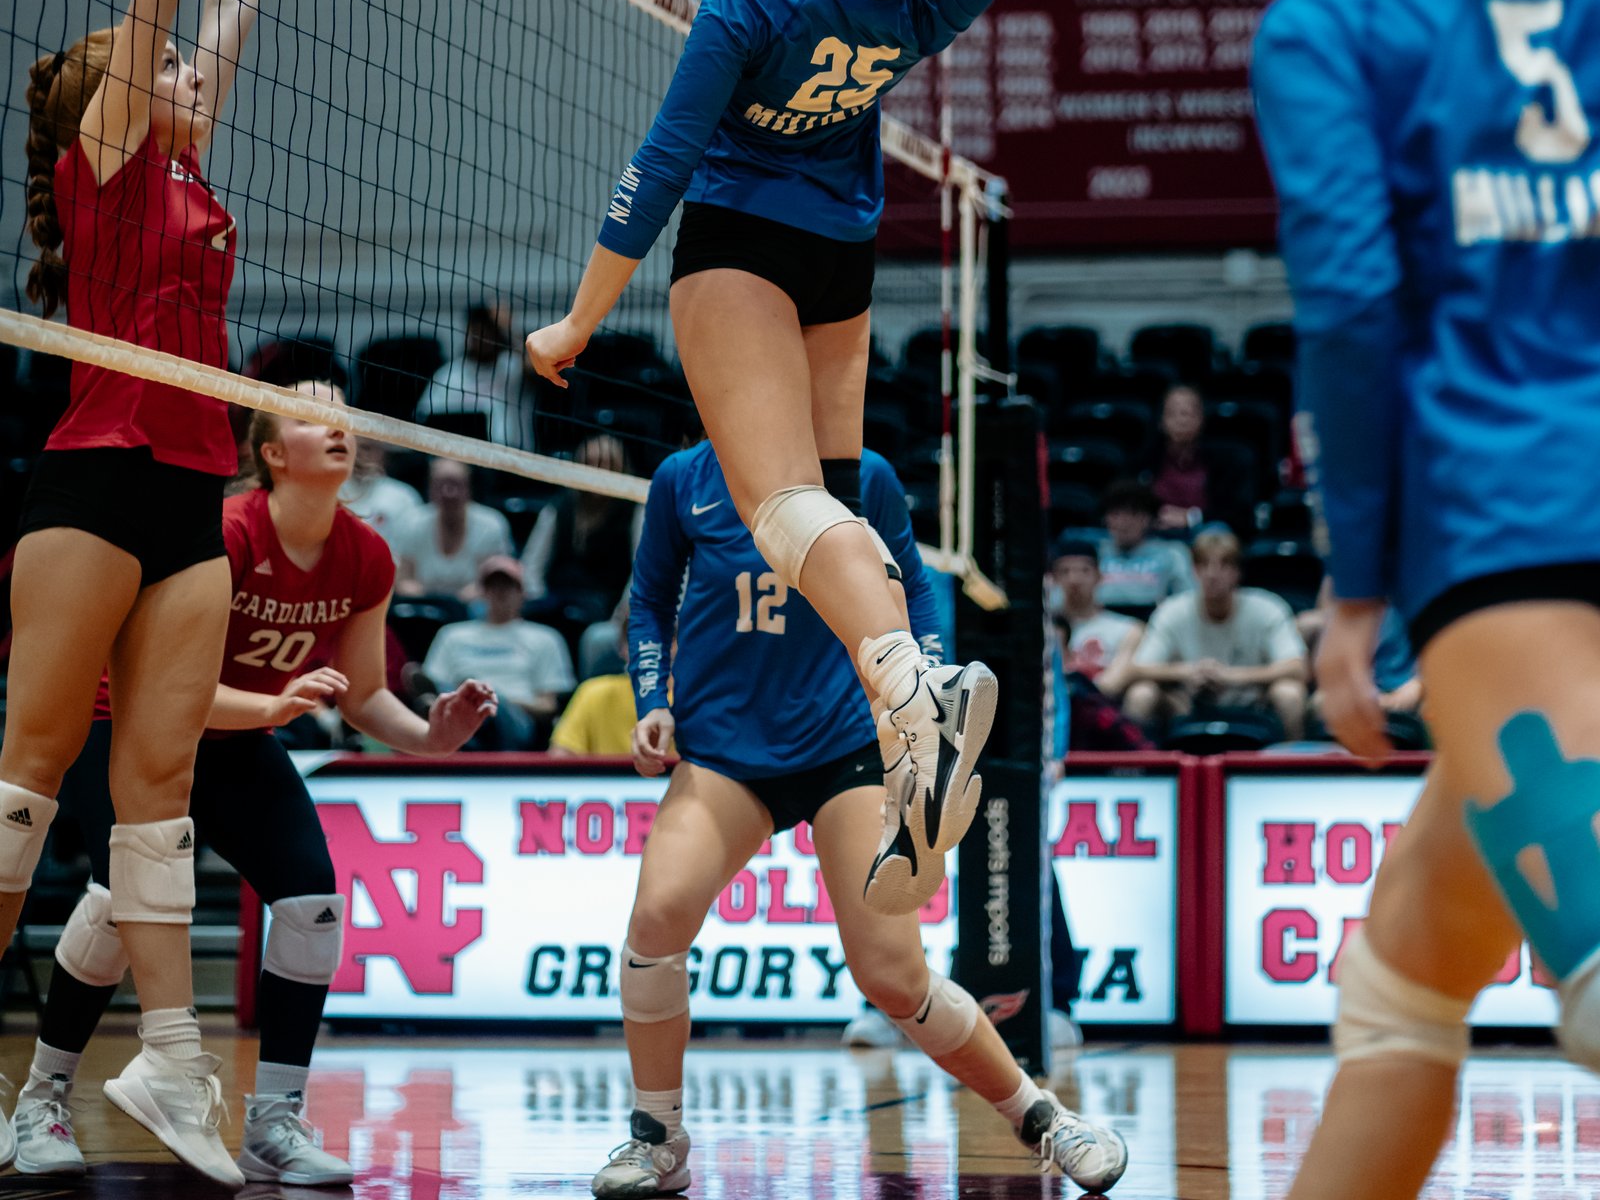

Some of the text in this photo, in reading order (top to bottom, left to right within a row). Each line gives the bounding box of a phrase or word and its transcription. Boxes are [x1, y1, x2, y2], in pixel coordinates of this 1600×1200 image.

[786, 37, 900, 112] 25
[231, 590, 352, 625] CARDINALS
[735, 571, 788, 635] 12
[233, 629, 316, 672] 20
[526, 946, 847, 998] GRORY
